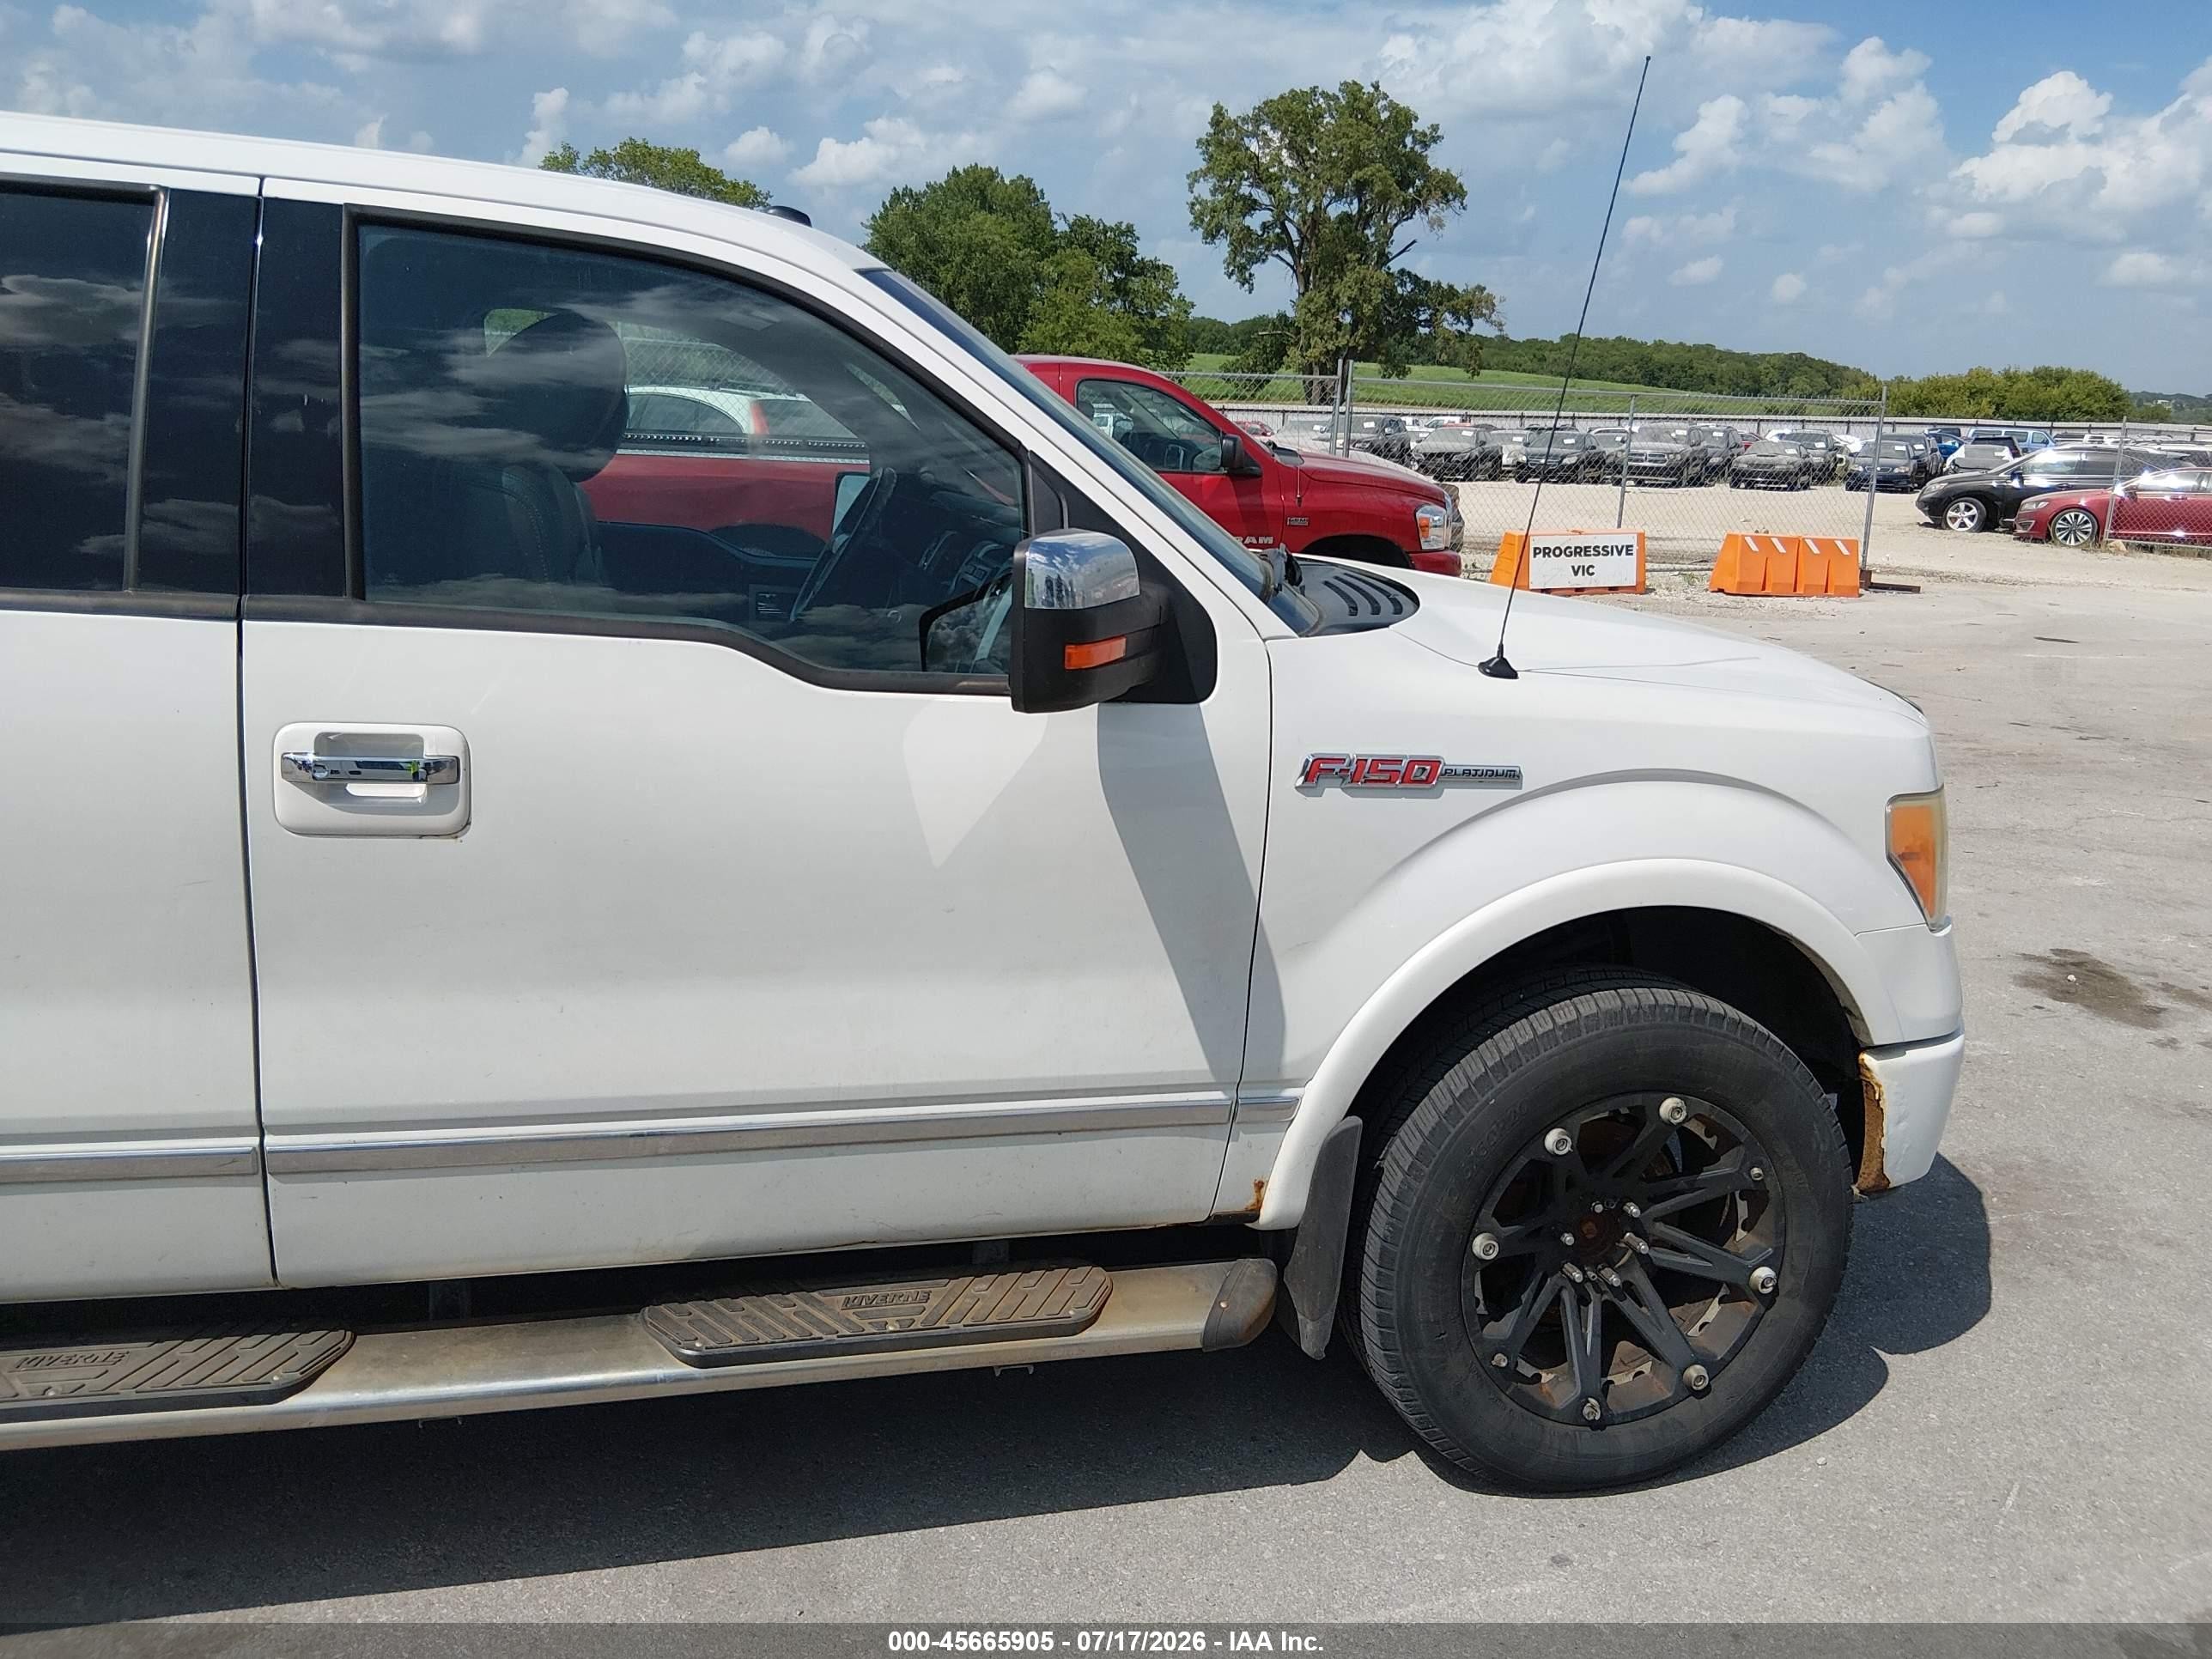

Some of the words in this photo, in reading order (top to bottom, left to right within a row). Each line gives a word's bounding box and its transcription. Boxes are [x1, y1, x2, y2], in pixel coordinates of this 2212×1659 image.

[1533, 544, 1634, 558] PROGRESSIVE
[1571, 564, 1595, 577] VIC
[1301, 754, 1443, 787] F-150
[1443, 768, 1520, 780] PLATINUM
